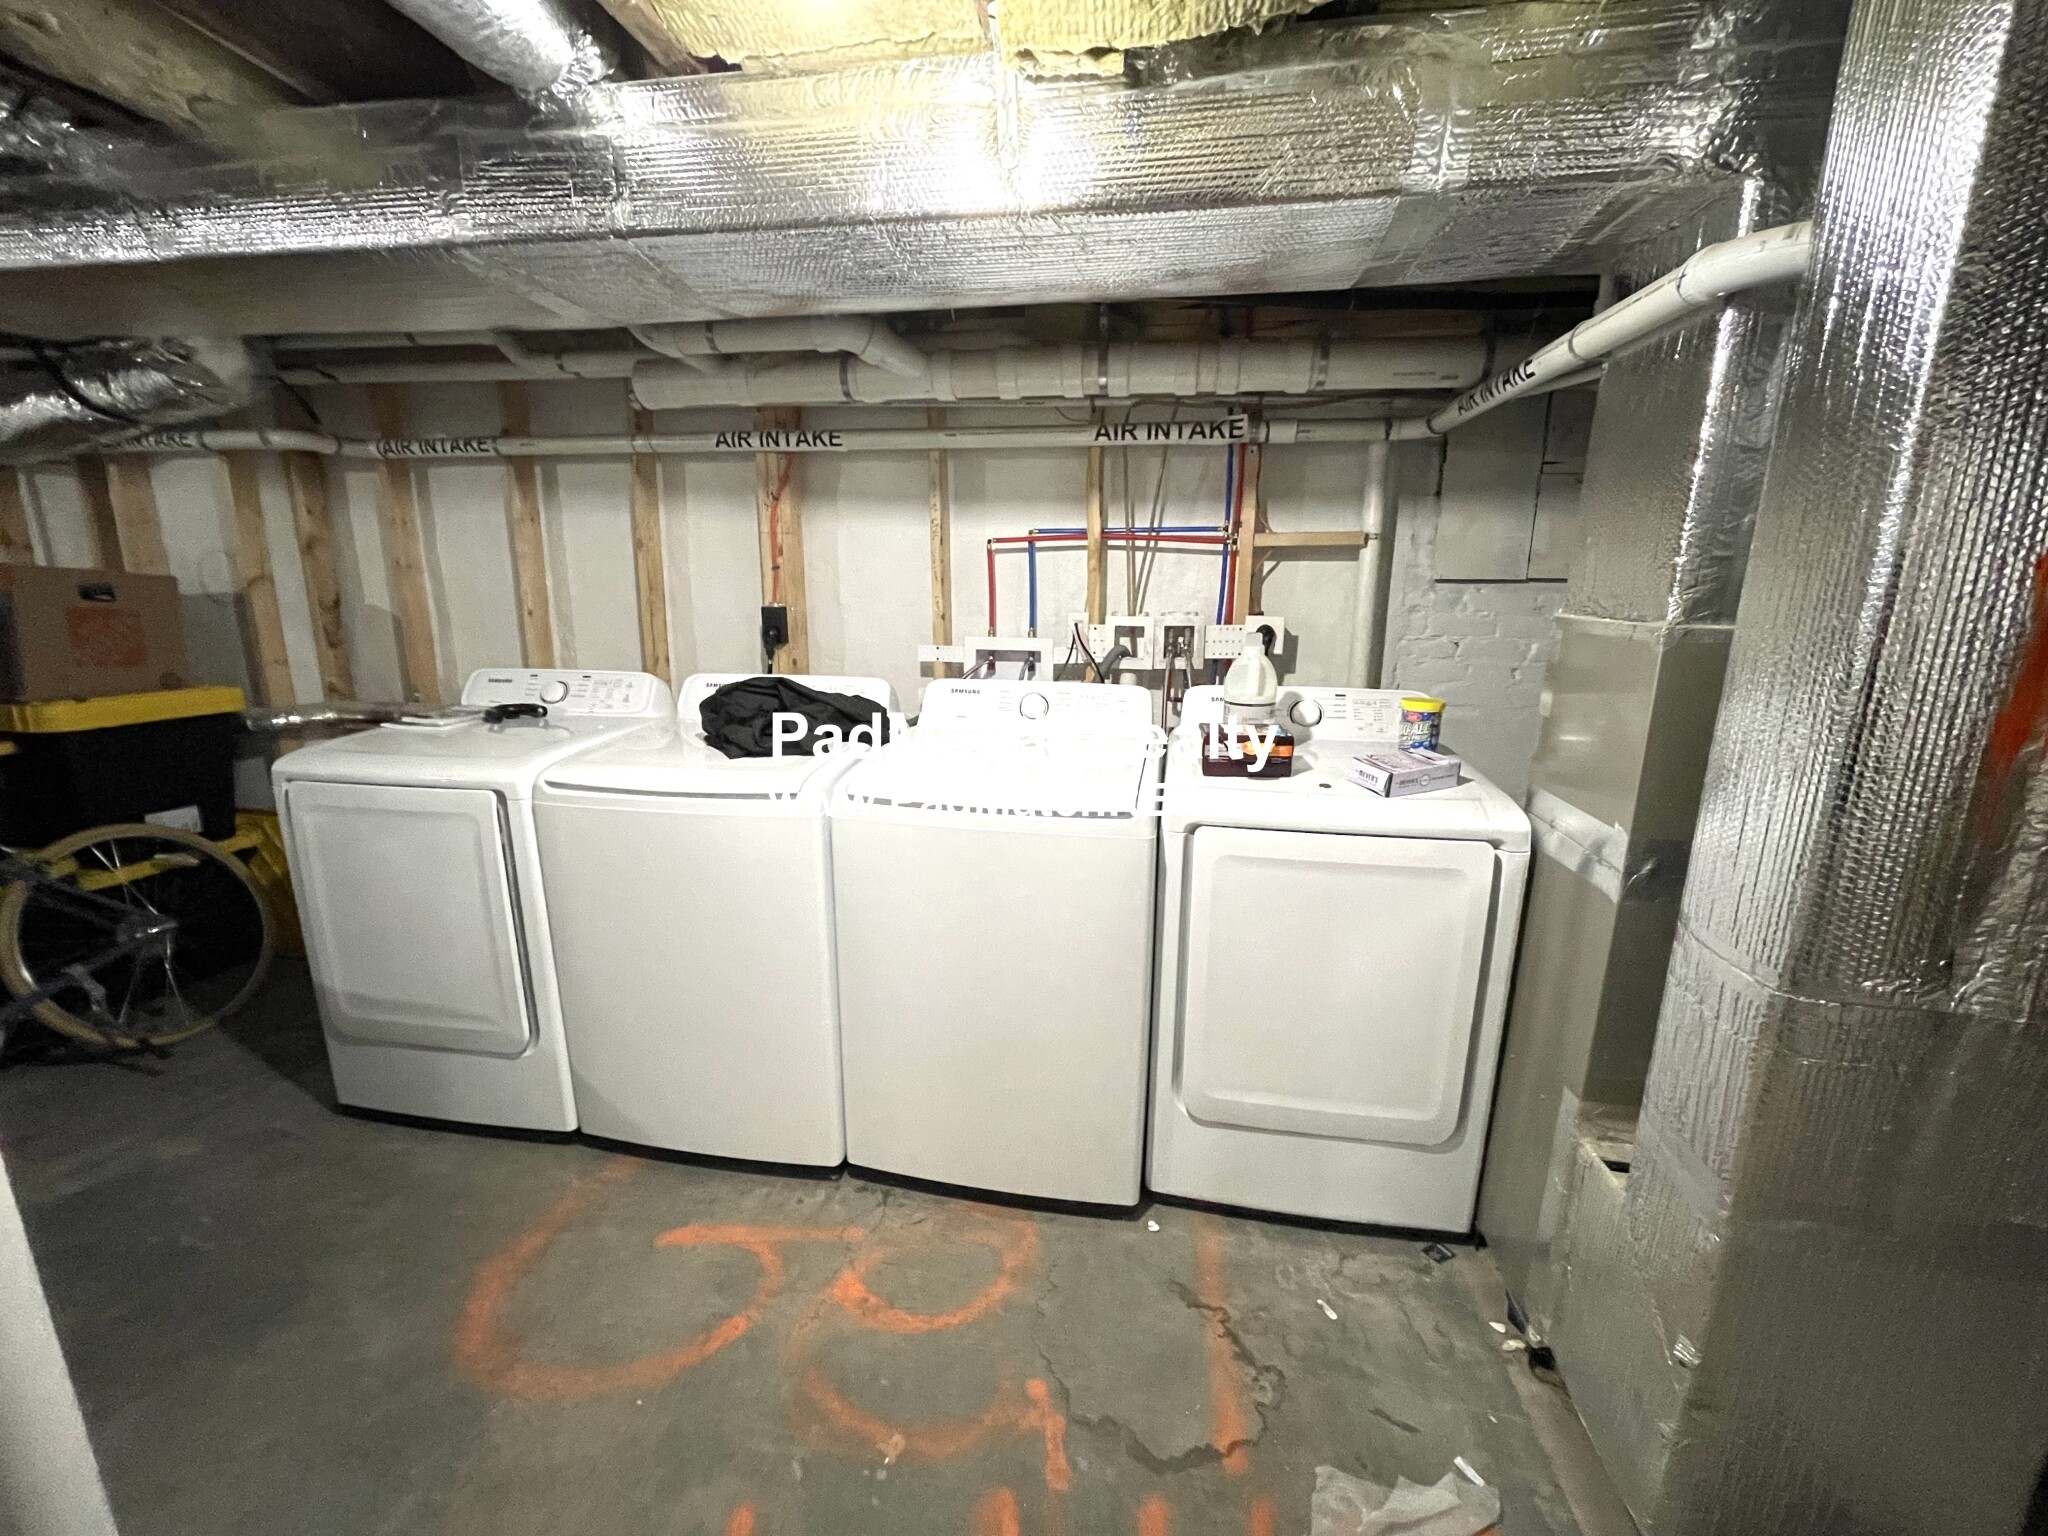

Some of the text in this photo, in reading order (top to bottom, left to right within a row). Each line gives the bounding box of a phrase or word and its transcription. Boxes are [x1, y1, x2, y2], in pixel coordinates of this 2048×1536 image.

[715, 430, 843, 448] AIR INTAKE
[1094, 418, 1246, 442] AIR INTAKE
[382, 436, 490, 456] AIR INTAKE
